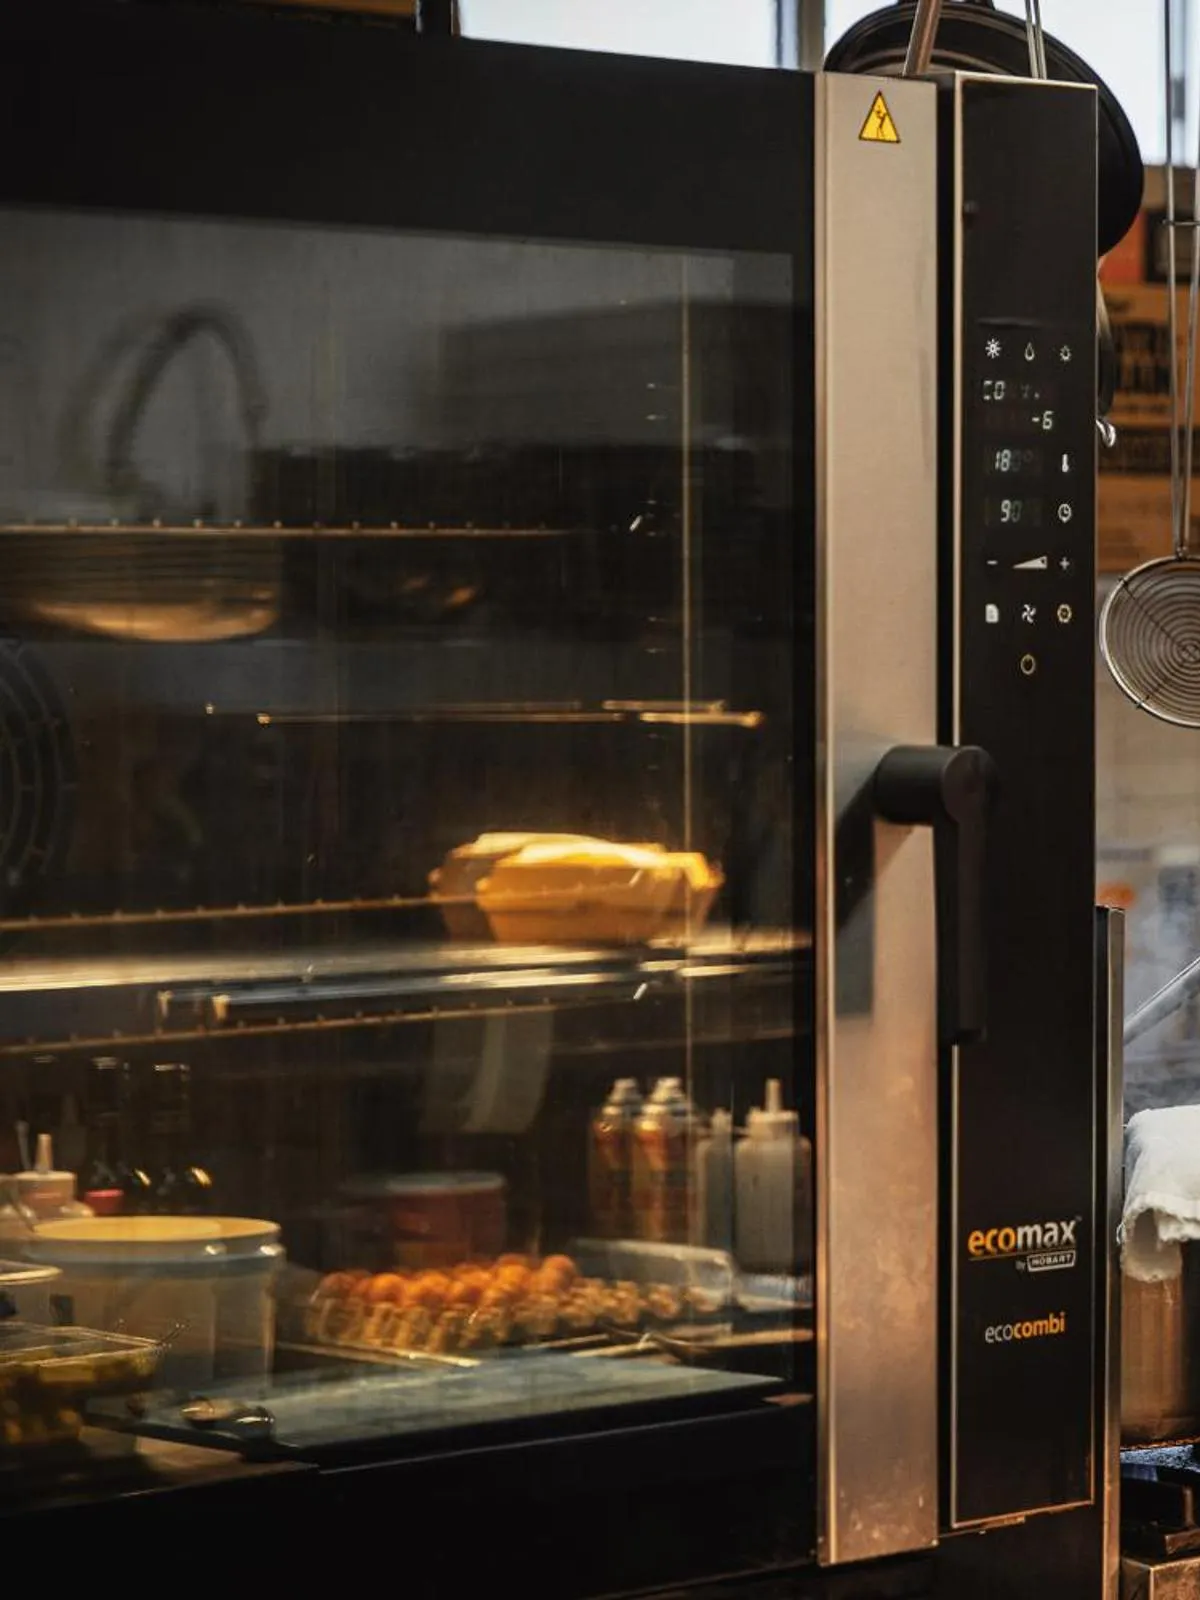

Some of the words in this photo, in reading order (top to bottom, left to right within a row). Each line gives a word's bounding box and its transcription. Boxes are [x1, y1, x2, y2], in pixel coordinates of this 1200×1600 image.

[967, 1219, 1077, 1256] ecomax
[1031, 1253, 1072, 1268] HOBART
[985, 1311, 1066, 1343] ecocombi
